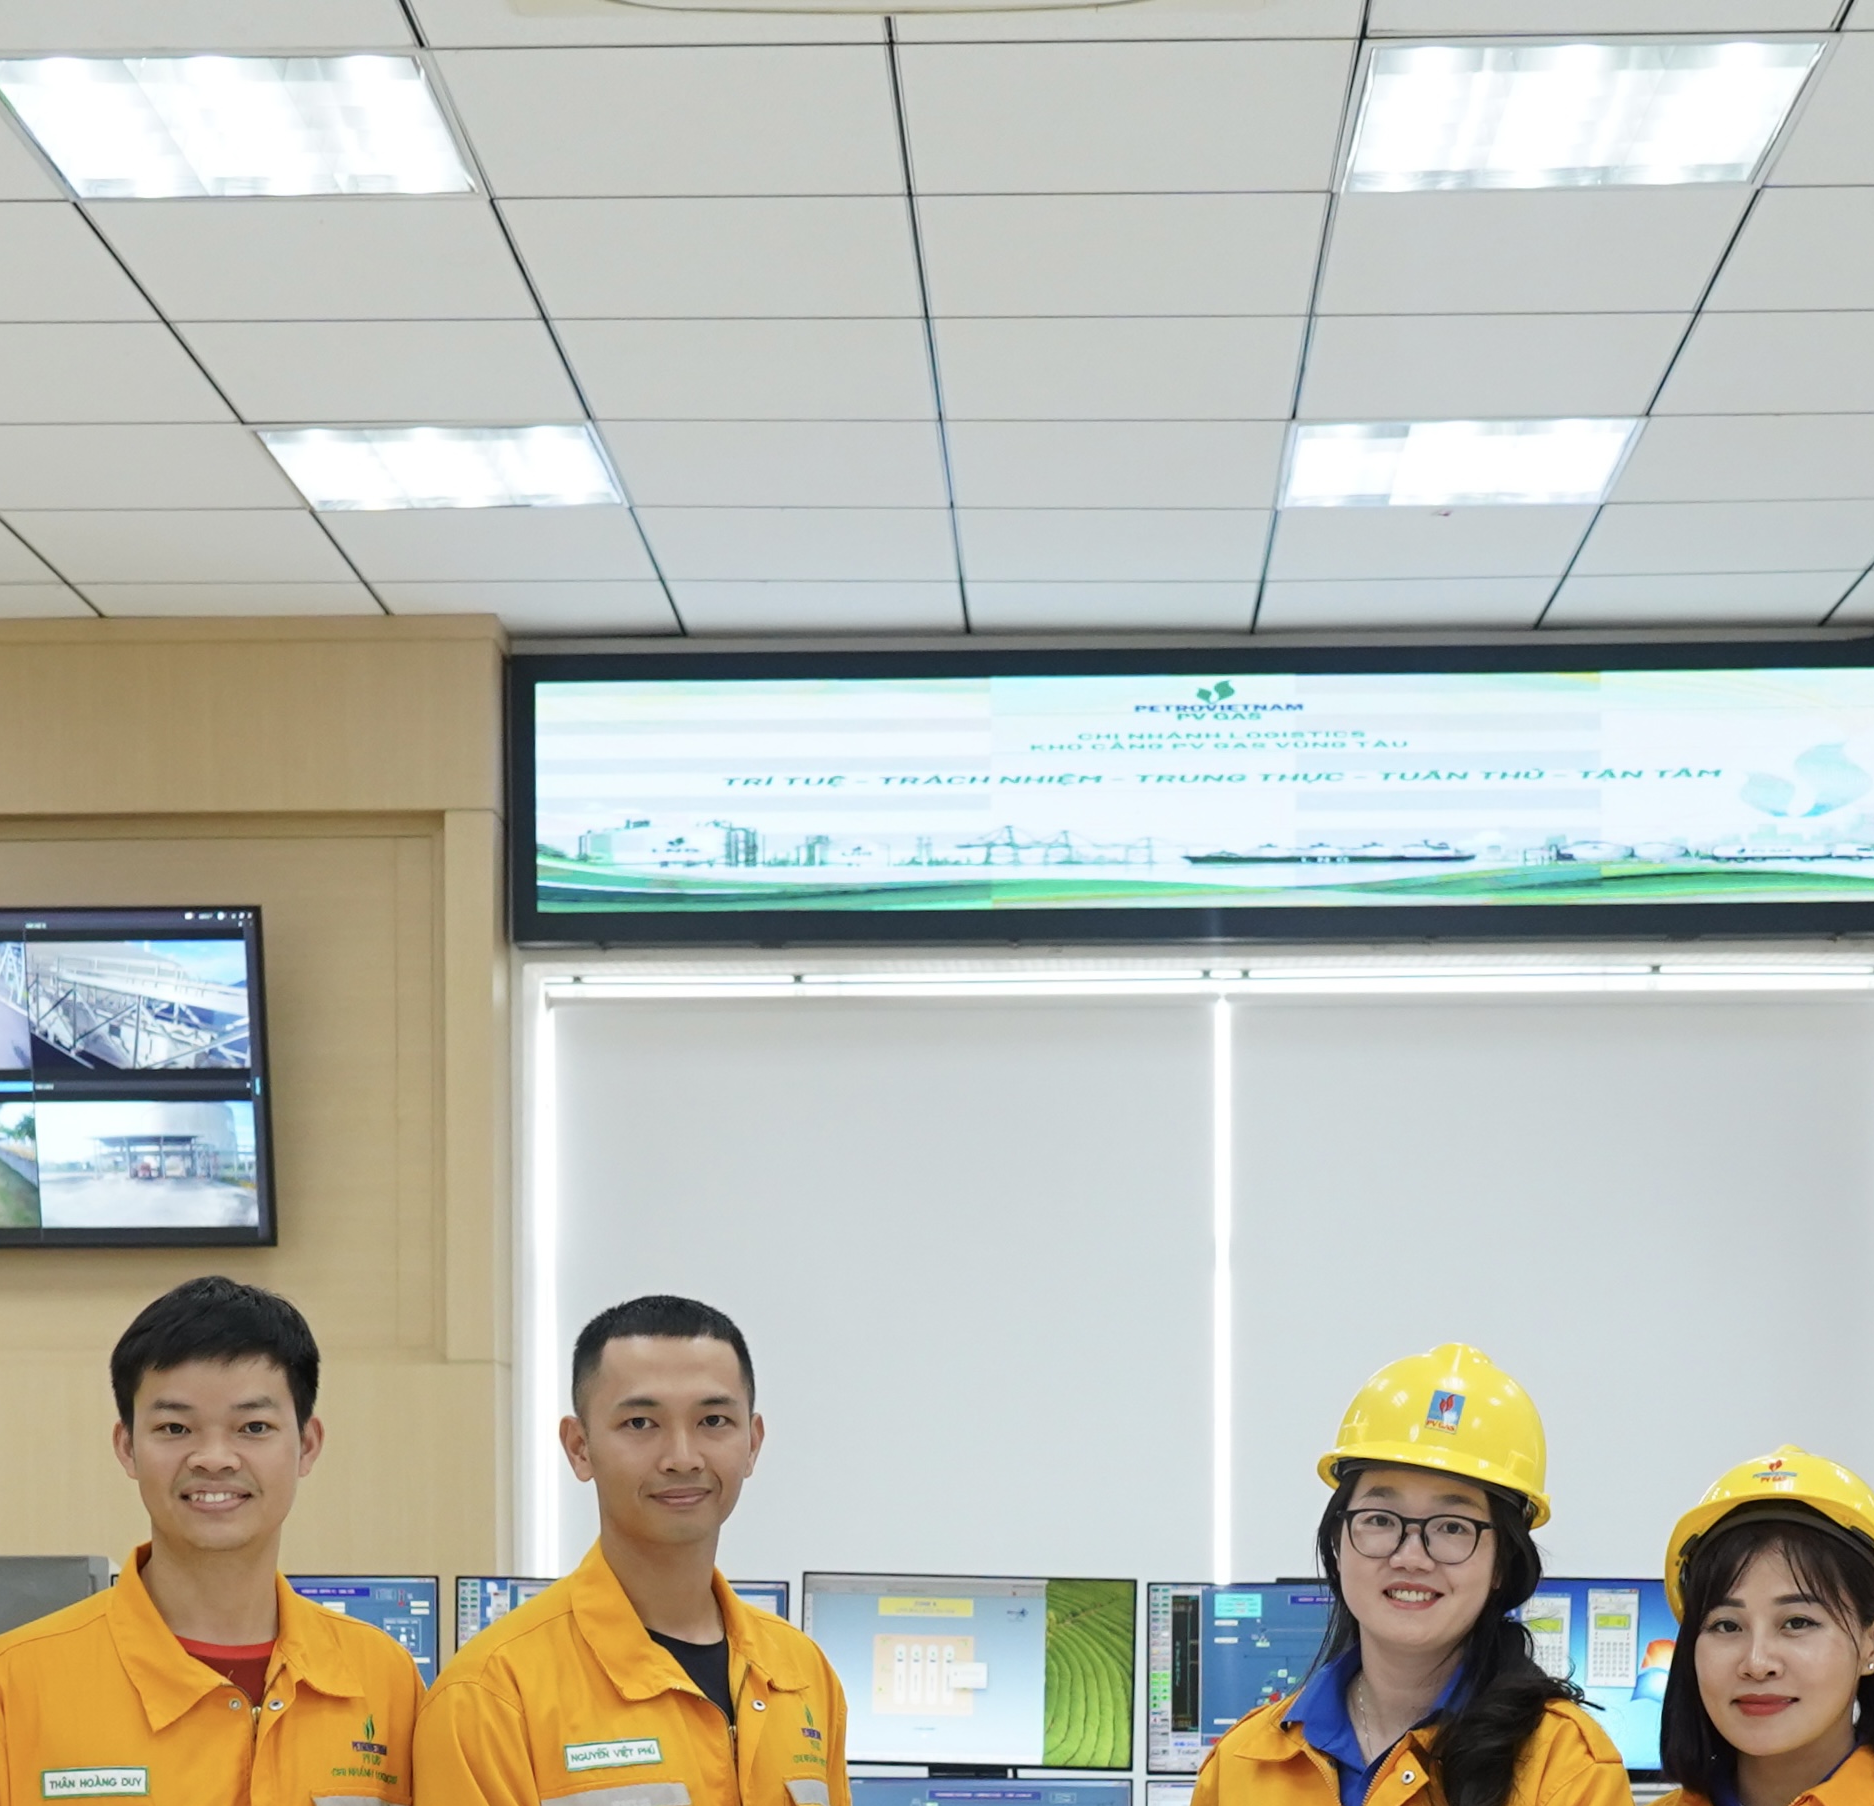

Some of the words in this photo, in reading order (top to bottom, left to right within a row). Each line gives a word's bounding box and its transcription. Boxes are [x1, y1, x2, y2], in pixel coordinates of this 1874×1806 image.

[1134, 703, 1304, 713] PETROVIETNAM
[1177, 712, 1206, 721] PV
[1213, 712, 1262, 721] GAS
[1078, 732, 1120, 741] CHI
[1229, 730, 1366, 739] LOGISTICS
[1030, 743, 1083, 751] KHO
[1171, 742, 1205, 750] PV
[1213, 742, 1267, 750] GAS
[724, 775, 774, 787] TRÍ
[881, 774, 991, 786] TRÁCH
[998, 773, 1105, 787] NHIỆM
[1136, 773, 1247, 784] TRUNG
[1655, 767, 1723, 779] TÂM
[1426, 1418, 1438, 1428] PV
[570, 1747, 610, 1764] NGUYỄN
[612, 1745, 634, 1760] VIỆT
[637, 1744, 656, 1756] PHÚ
[49, 1776, 76, 1790] THÂN
[79, 1774, 118, 1788] HOÀNG
[121, 1777, 142, 1787] DUY
